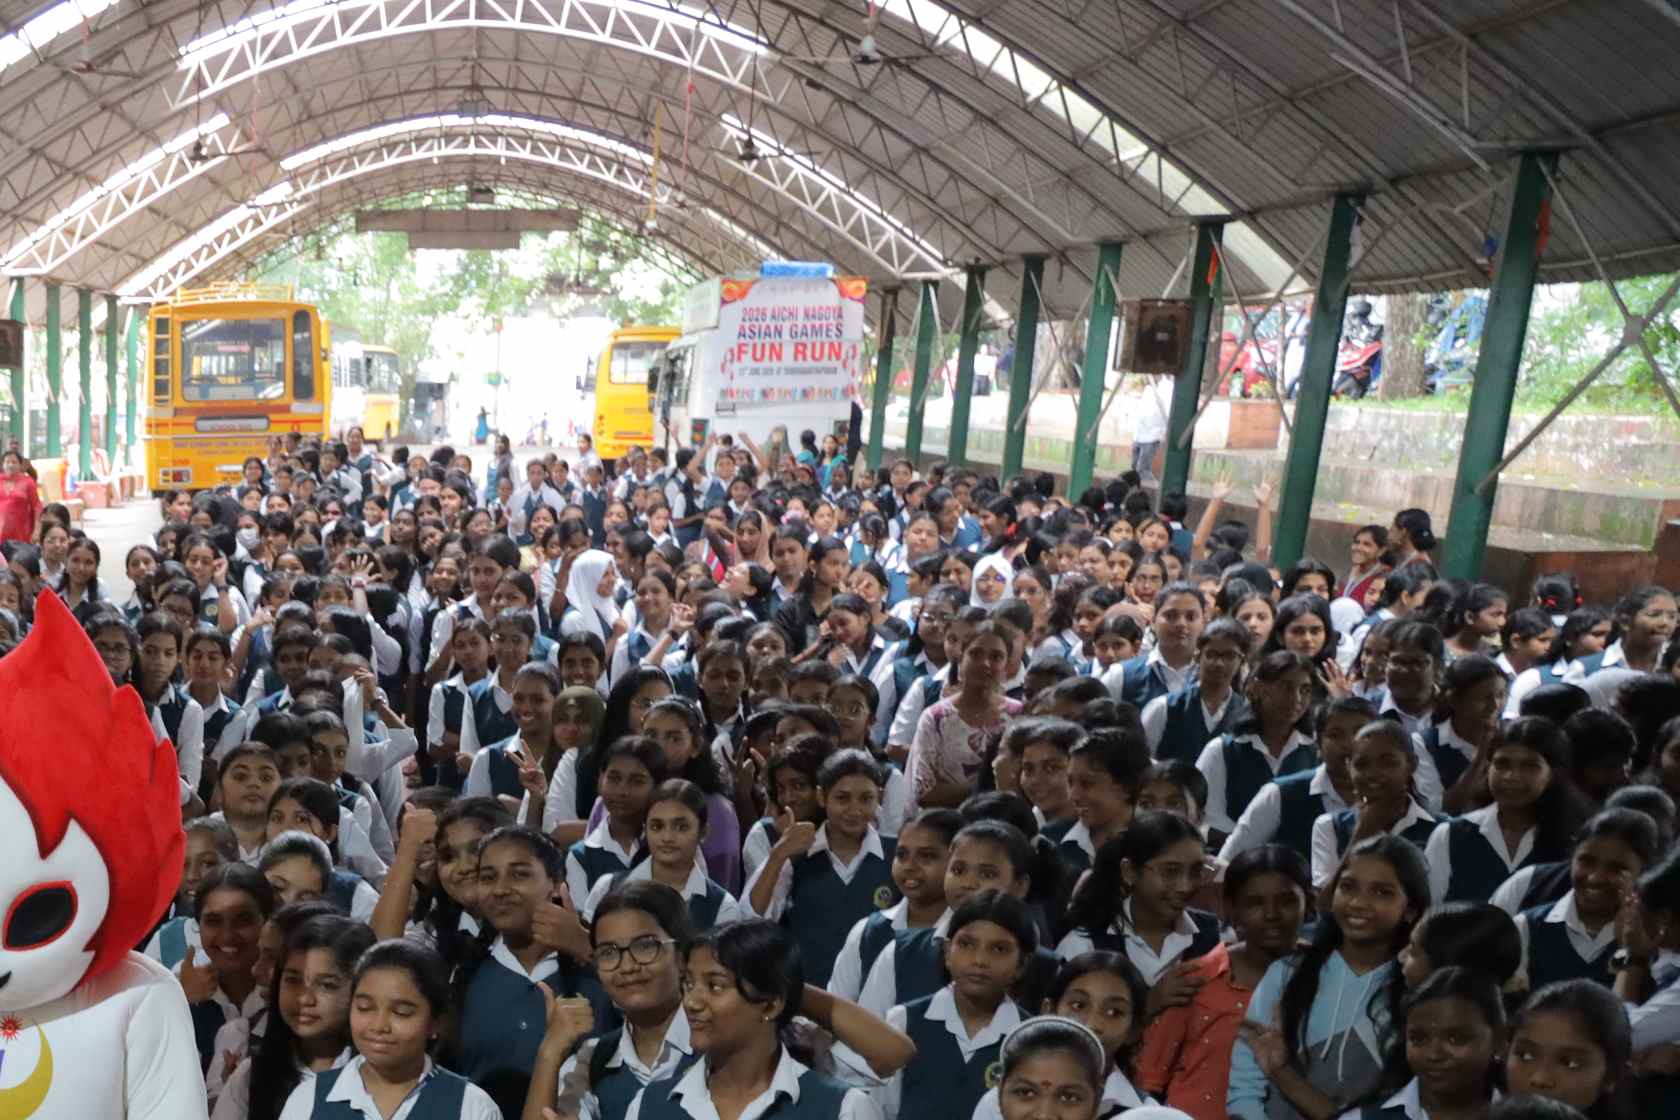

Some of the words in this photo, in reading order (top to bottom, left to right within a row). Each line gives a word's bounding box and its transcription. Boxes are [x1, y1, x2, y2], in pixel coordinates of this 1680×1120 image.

[770, 305, 798, 322] AICHI
[803, 304, 843, 321] NAGOYA
[737, 324, 783, 339] ASIAN
[789, 322, 843, 339] GAMES
[737, 342, 783, 362] FUN
[793, 342, 843, 362] RUN
